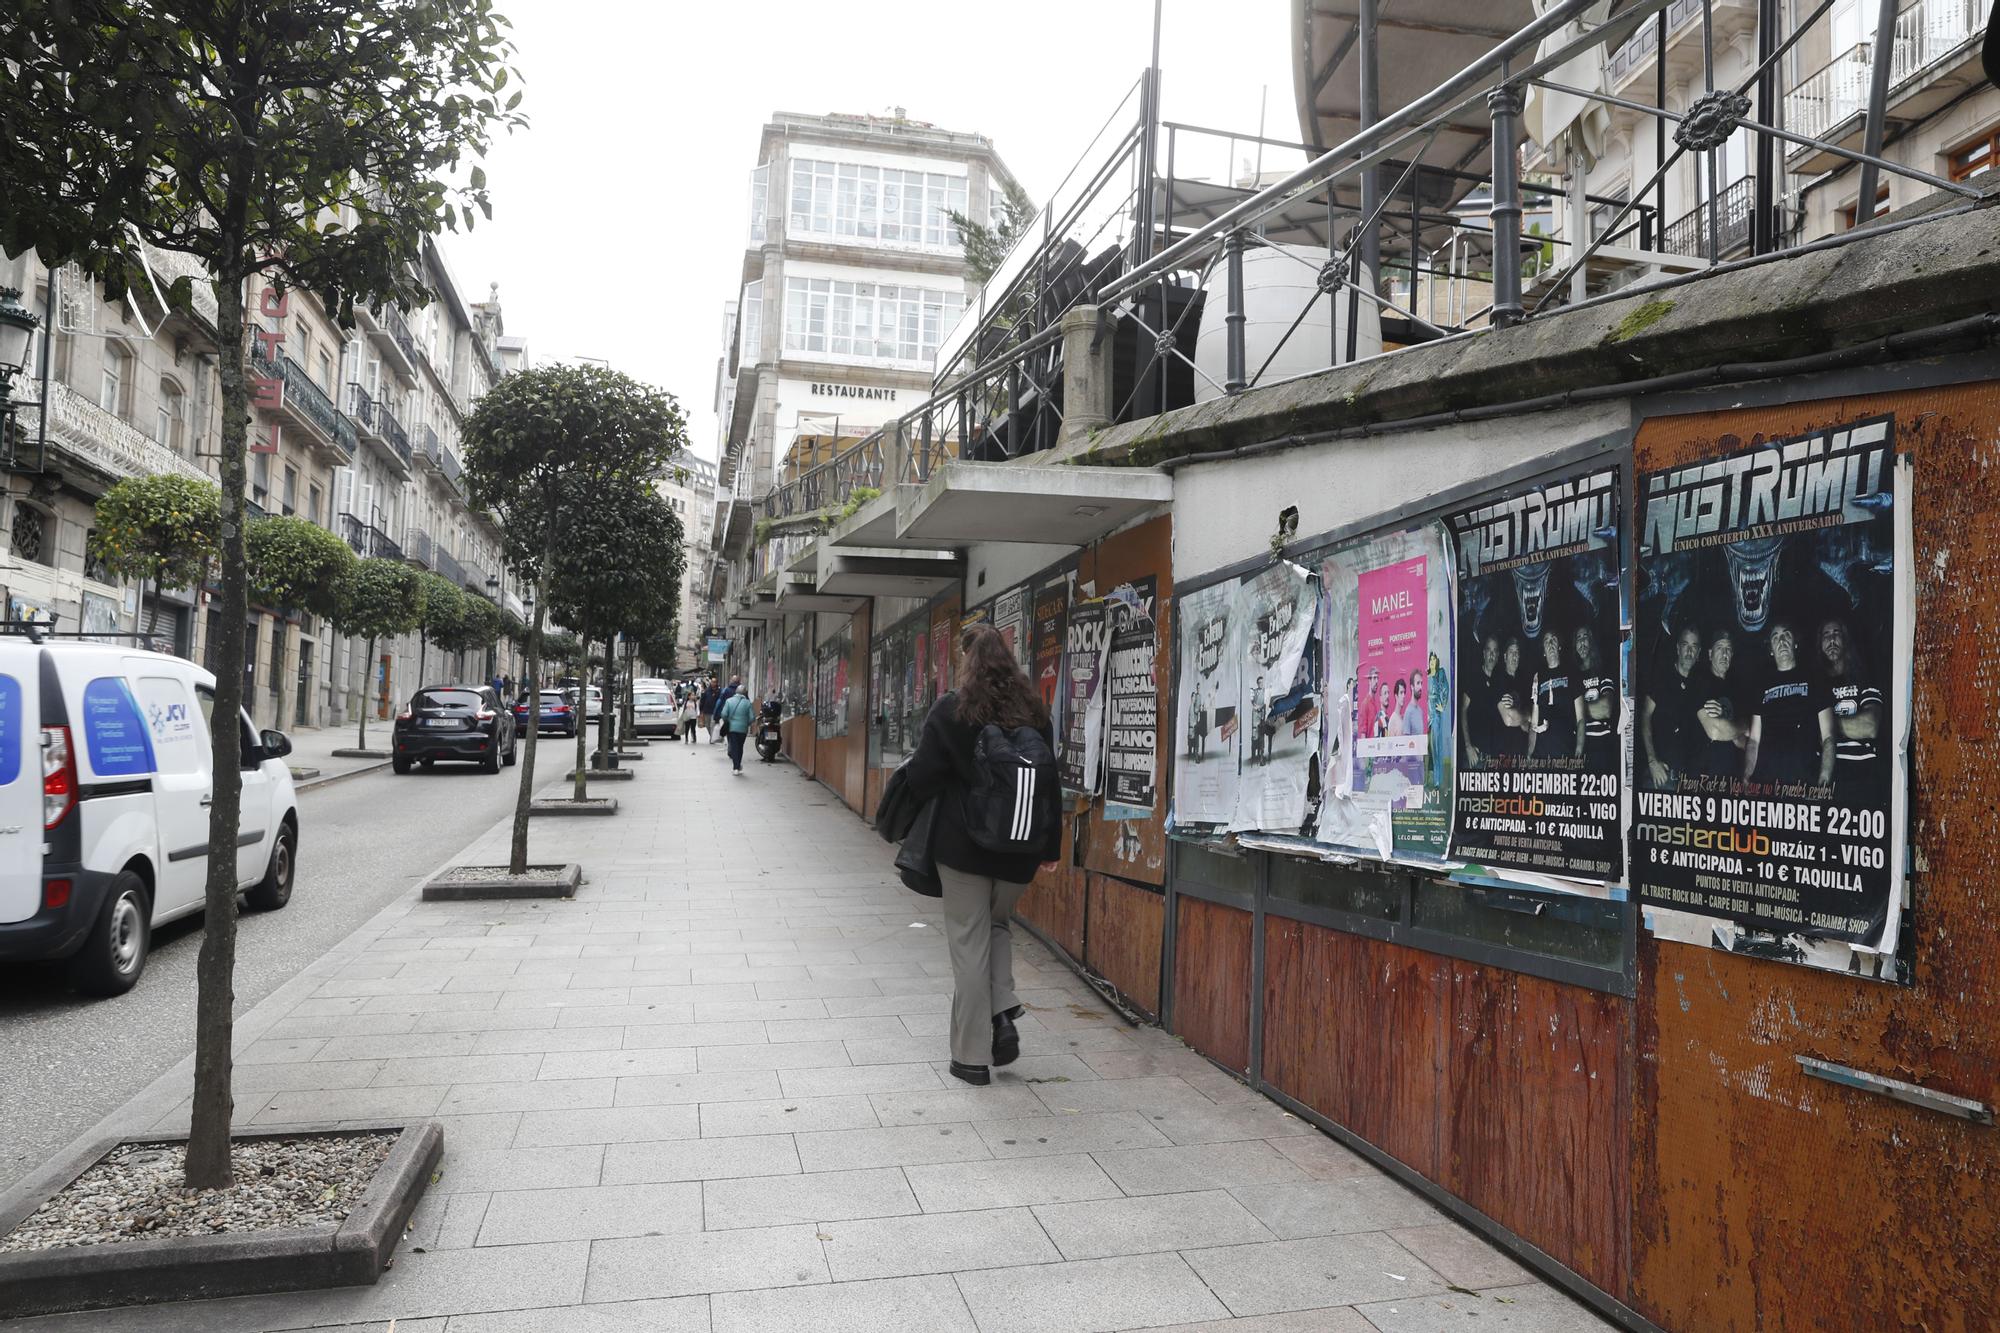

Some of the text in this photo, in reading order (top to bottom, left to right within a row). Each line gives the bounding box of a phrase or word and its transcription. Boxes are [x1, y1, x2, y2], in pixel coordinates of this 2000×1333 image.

[812, 383, 896, 401] RESTAURANTE
[1640, 421, 1888, 557] NOSTROMO
[1453, 471, 1613, 580] NOSTROMO
[1674, 513, 1844, 552] ÚNICO CONCIERTO XXX ANIVERSARIO
[1496, 556, 1529, 571] CONCIERTO
[1529, 550, 1544, 564] XXX
[1545, 543, 1590, 561] ANIVERSARIO
[1372, 590, 1413, 615] MANEL
[1067, 621, 1104, 653] ROCK
[1389, 631, 1417, 642] PONTEVEDRA
[1112, 675, 1155, 694] MUSICAL
[166, 703, 186, 721] JCV
[1110, 730, 1155, 747] PIANO
[1459, 772, 1617, 797] VIERNES 9 DICIEMBRE 22:00
[1458, 794, 1544, 816] masterclub
[1545, 802, 1574, 818] URZÁIZ
[1576, 806, 1581, 818] 1
[1590, 802, 1617, 820] VIGO
[1638, 792, 1885, 839] VIERNES 9 DICIEMBRE 22:00
[1465, 817, 1470, 829] 8
[1471, 818, 1478, 829] €
[1480, 818, 1526, 833] ANTICIPADA
[1535, 822, 1546, 835] 10
[1547, 822, 1556, 836] €
[1558, 822, 1604, 841] TAQUILLA
[1511, 837, 1517, 847] DE
[1637, 822, 1769, 856] masterclub
[1772, 840, 1815, 860] URZÁIZ
[1819, 847, 1826, 862] 1
[1841, 844, 1885, 869] VIGO
[1487, 849, 1497, 859] BAR
[1500, 851, 1516, 862] CARPE
[1516, 853, 1529, 863] DIEM
[1569, 859, 1595, 872] CARAMBA
[1650, 848, 1657, 863] 8
[1659, 850, 1669, 865] €
[1672, 851, 1743, 875] ANTICIPADA
[1757, 861, 1774, 880] 10
[1777, 864, 1789, 883] €
[1793, 866, 1863, 893] TAQUILLA
[1695, 874, 1800, 903] PUNTOS DE VENTA ANTICIPADA:
[1641, 884, 1649, 896] AL
[1650, 884, 1671, 901] TRASTE
[1672, 888, 1688, 904] ROCK
[1690, 891, 1703, 905] BAR
[1709, 894, 1730, 911] CARPE
[1731, 898, 1749, 914] DIEM
[1755, 901, 1803, 923] MIDI-MÚSICA
[1810, 913, 1847, 932] CARAMBA
[1847, 919, 1870, 935] SHOP
